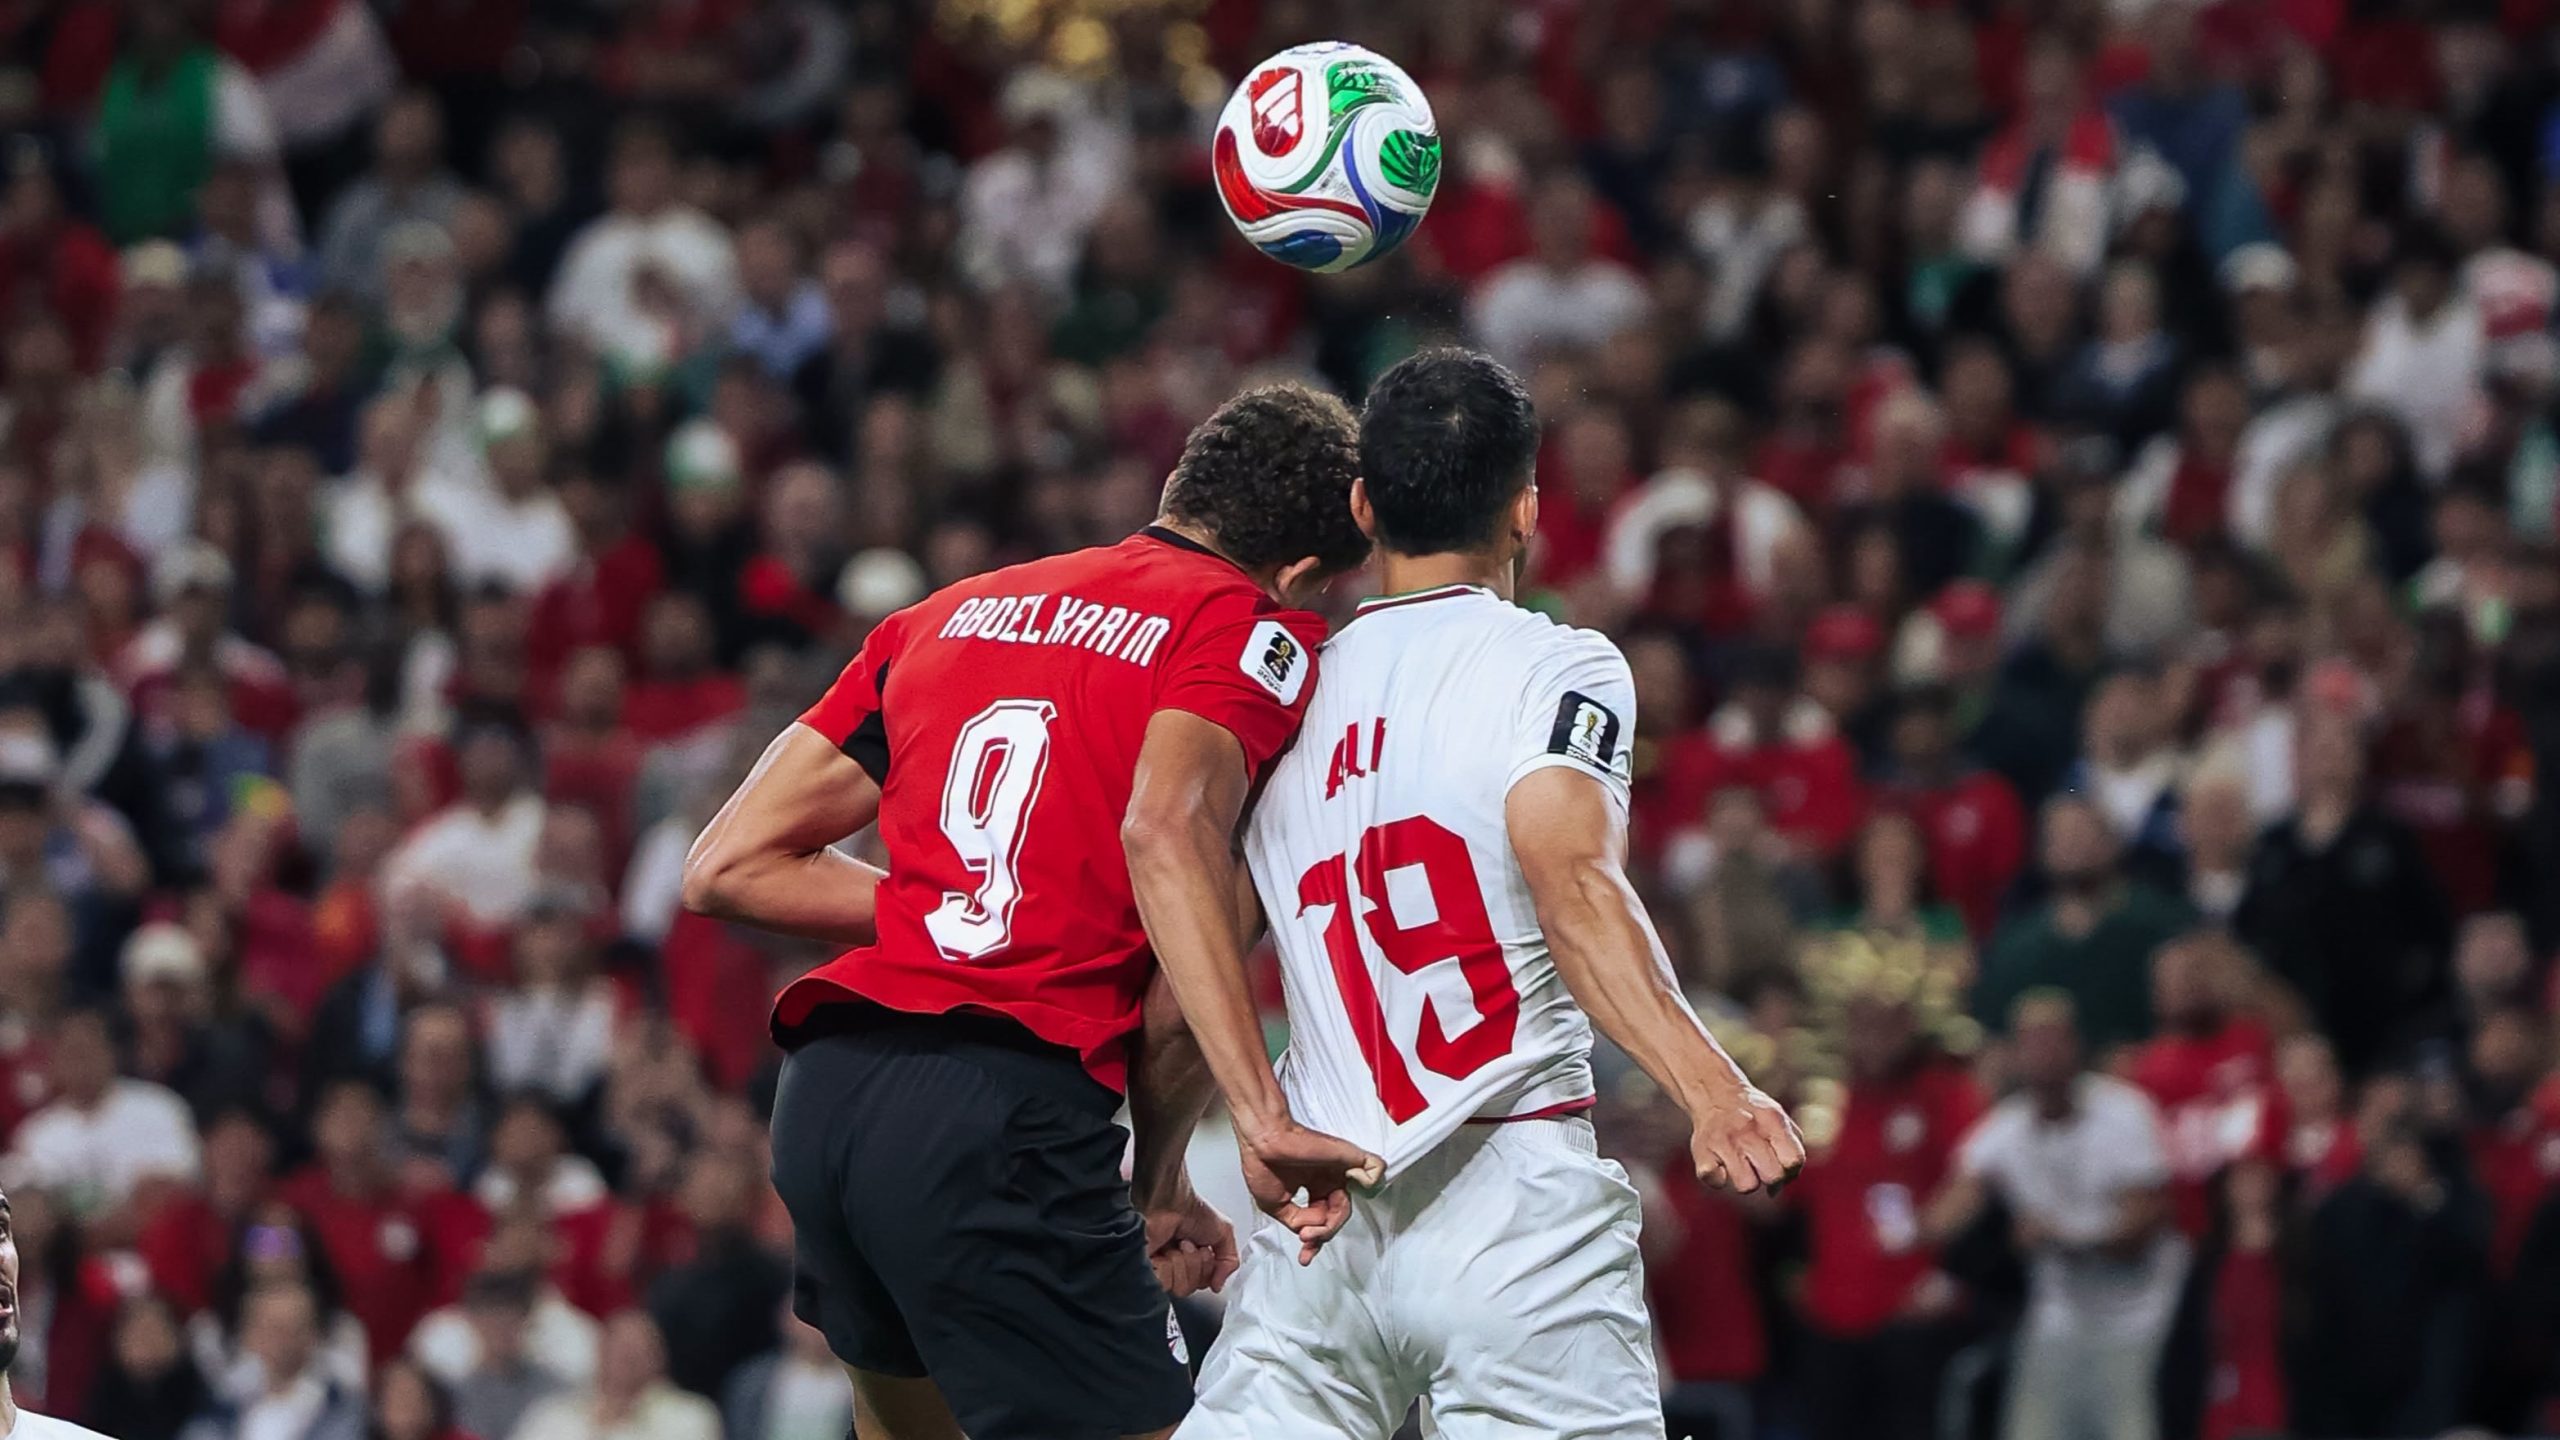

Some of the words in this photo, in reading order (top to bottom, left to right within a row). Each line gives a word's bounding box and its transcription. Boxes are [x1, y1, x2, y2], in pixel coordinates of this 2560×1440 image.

[938, 594, 1171, 667] ABDELKARIM
[924, 698, 1058, 961] 9
[1325, 717, 1387, 801] ALI
[1296, 814, 1520, 1125] 19
